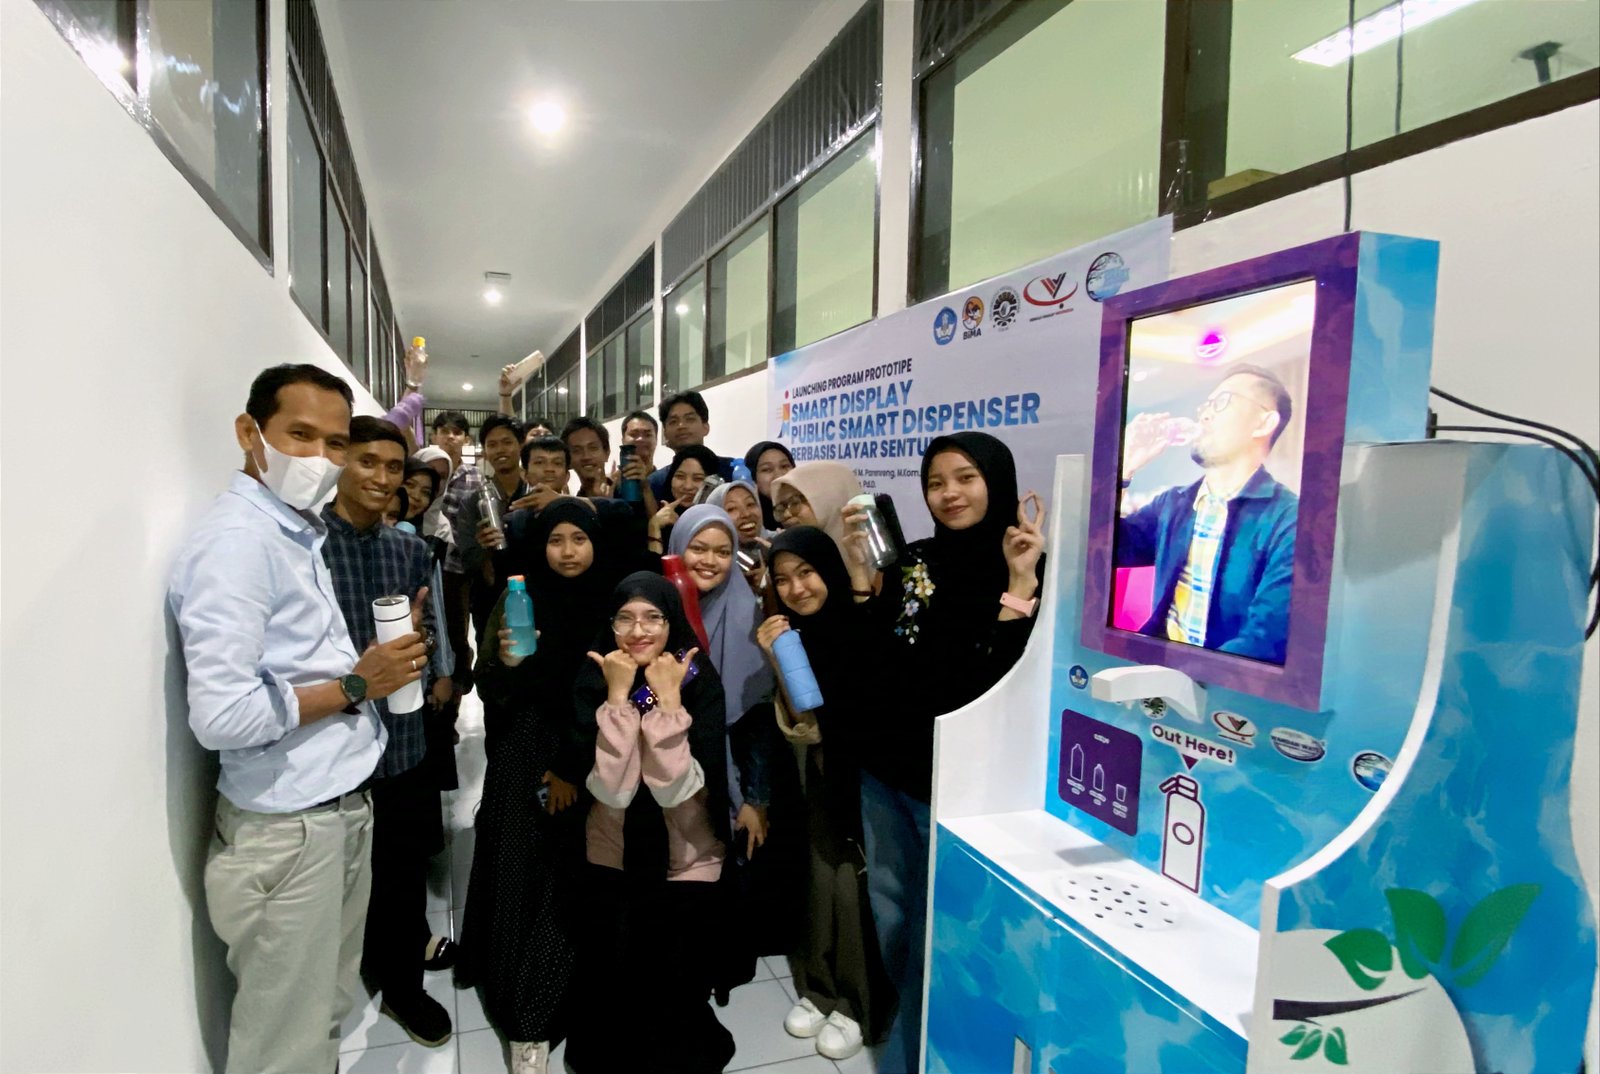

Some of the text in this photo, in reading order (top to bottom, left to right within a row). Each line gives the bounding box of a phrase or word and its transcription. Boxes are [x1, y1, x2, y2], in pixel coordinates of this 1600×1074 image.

[792, 358, 912, 399] LAUNCHING PROGRAM PROTOTIPE
[791, 379, 913, 422] SMART DISPLAY
[791, 392, 1040, 444] PUBLIC SMART DISPENSER
[791, 437, 933, 461] BERBASIS LAYAR SENTU
[1151, 725, 1182, 745] Out
[1185, 736, 1234, 763] Here!
